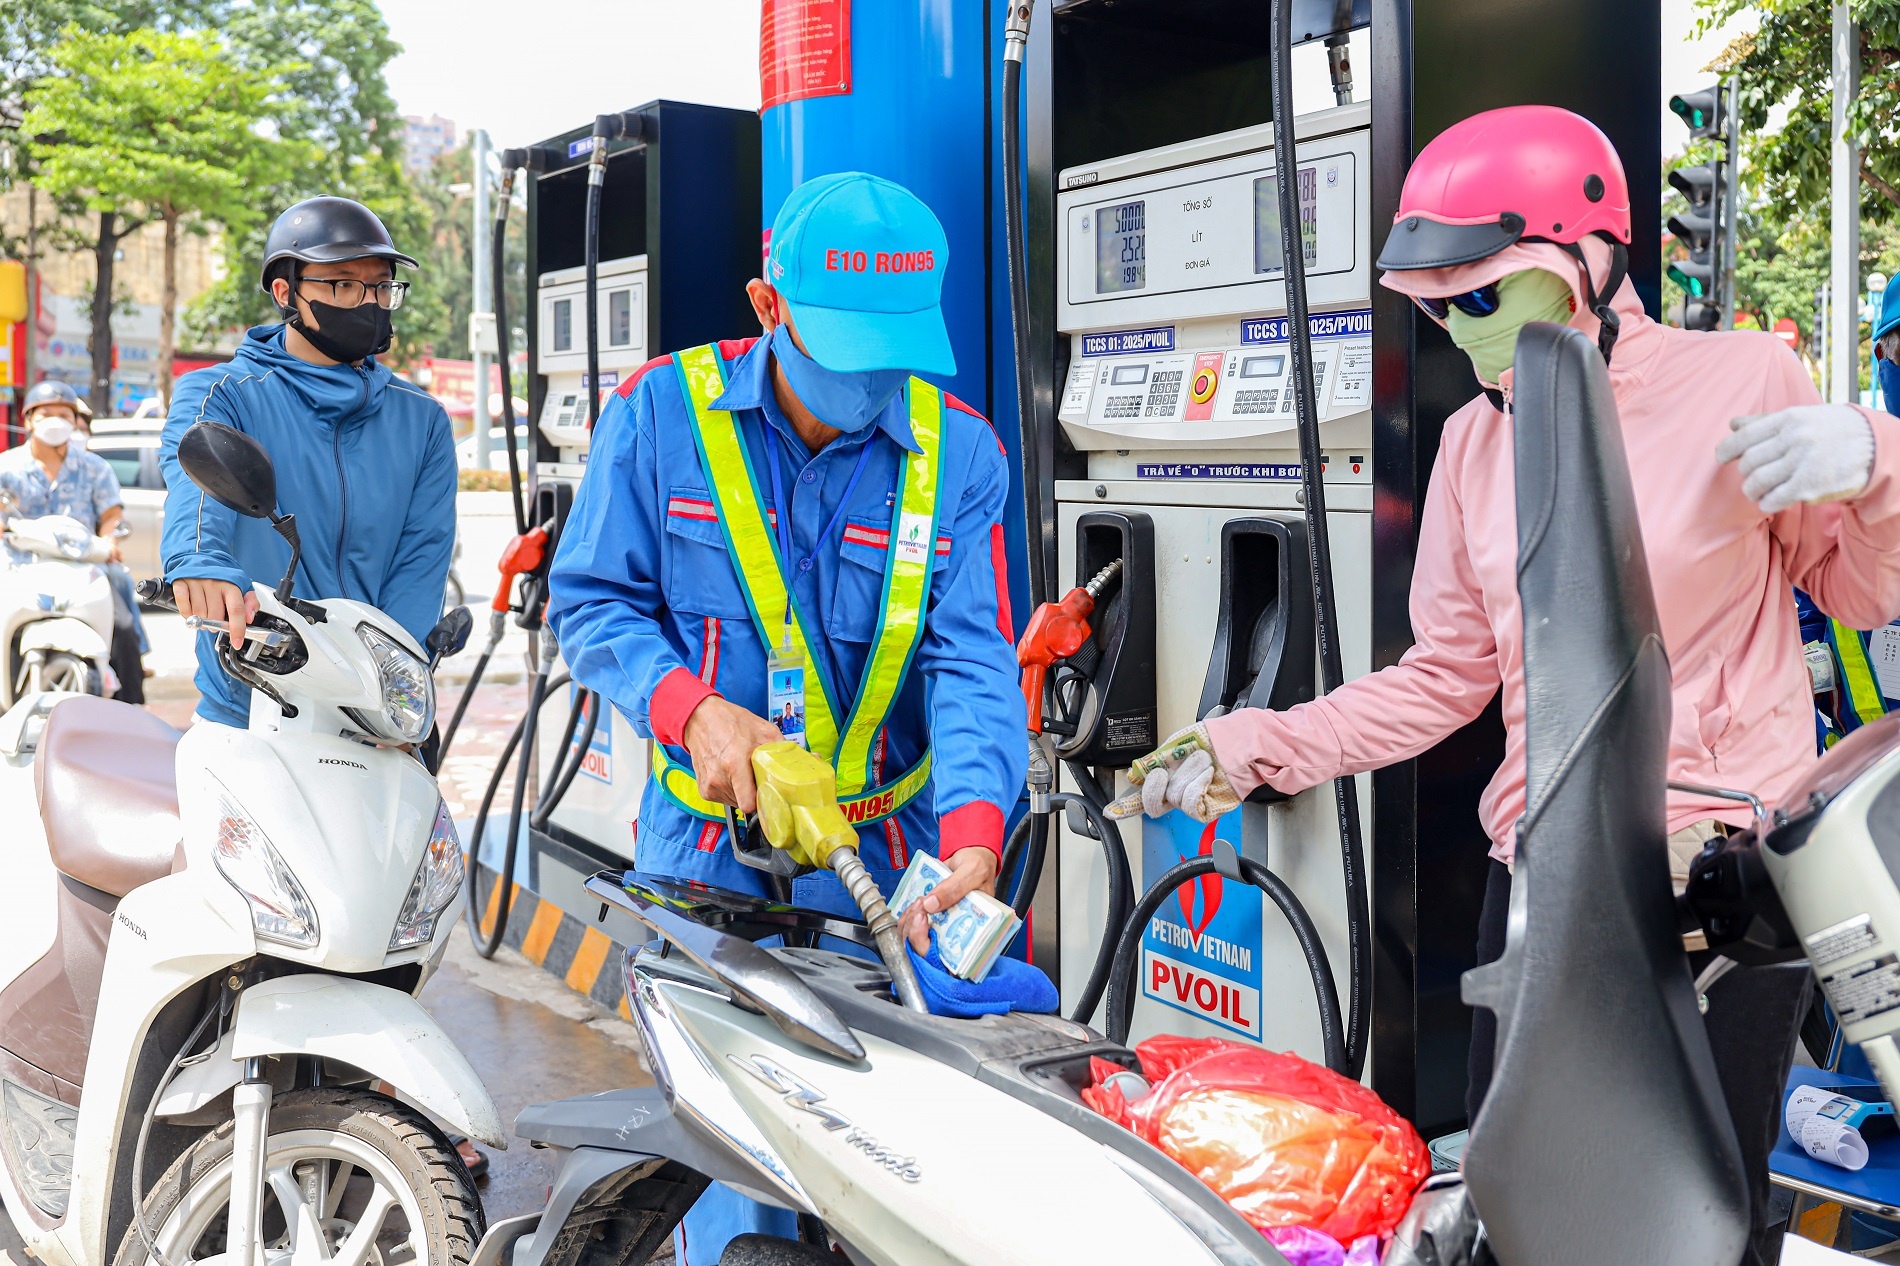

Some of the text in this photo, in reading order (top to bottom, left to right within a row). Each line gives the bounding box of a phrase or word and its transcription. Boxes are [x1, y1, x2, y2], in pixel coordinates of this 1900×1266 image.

[1068, 173, 1097, 186] TATSUNO
[1191, 230, 1203, 243] LÍT
[825, 249, 935, 274] E10 RON95
[1185, 257, 1211, 270] ĐƠN GIÁ
[1247, 321, 1278, 340] TCCS
[1086, 331, 1170, 353] TCCS 01: 2025/PVOIL
[1143, 464, 1166, 476] TRẢ
[1168, 464, 1182, 476] VỀ
[1208, 464, 1250, 476] TRƯỚC
[1252, 466, 1275, 477] KHI
[898, 540, 928, 550] PETROVIETNAM
[1320, 625, 1328, 656] FUTURA
[318, 758, 369, 771] HONDA
[118, 912, 148, 941] HONDA
[1152, 917, 1251, 973] PETROVIETNAM
[1152, 959, 1250, 1028] PVOIL
[1323, 1008, 1332, 1040] FUTURA
[845, 1127, 922, 1183] mode
